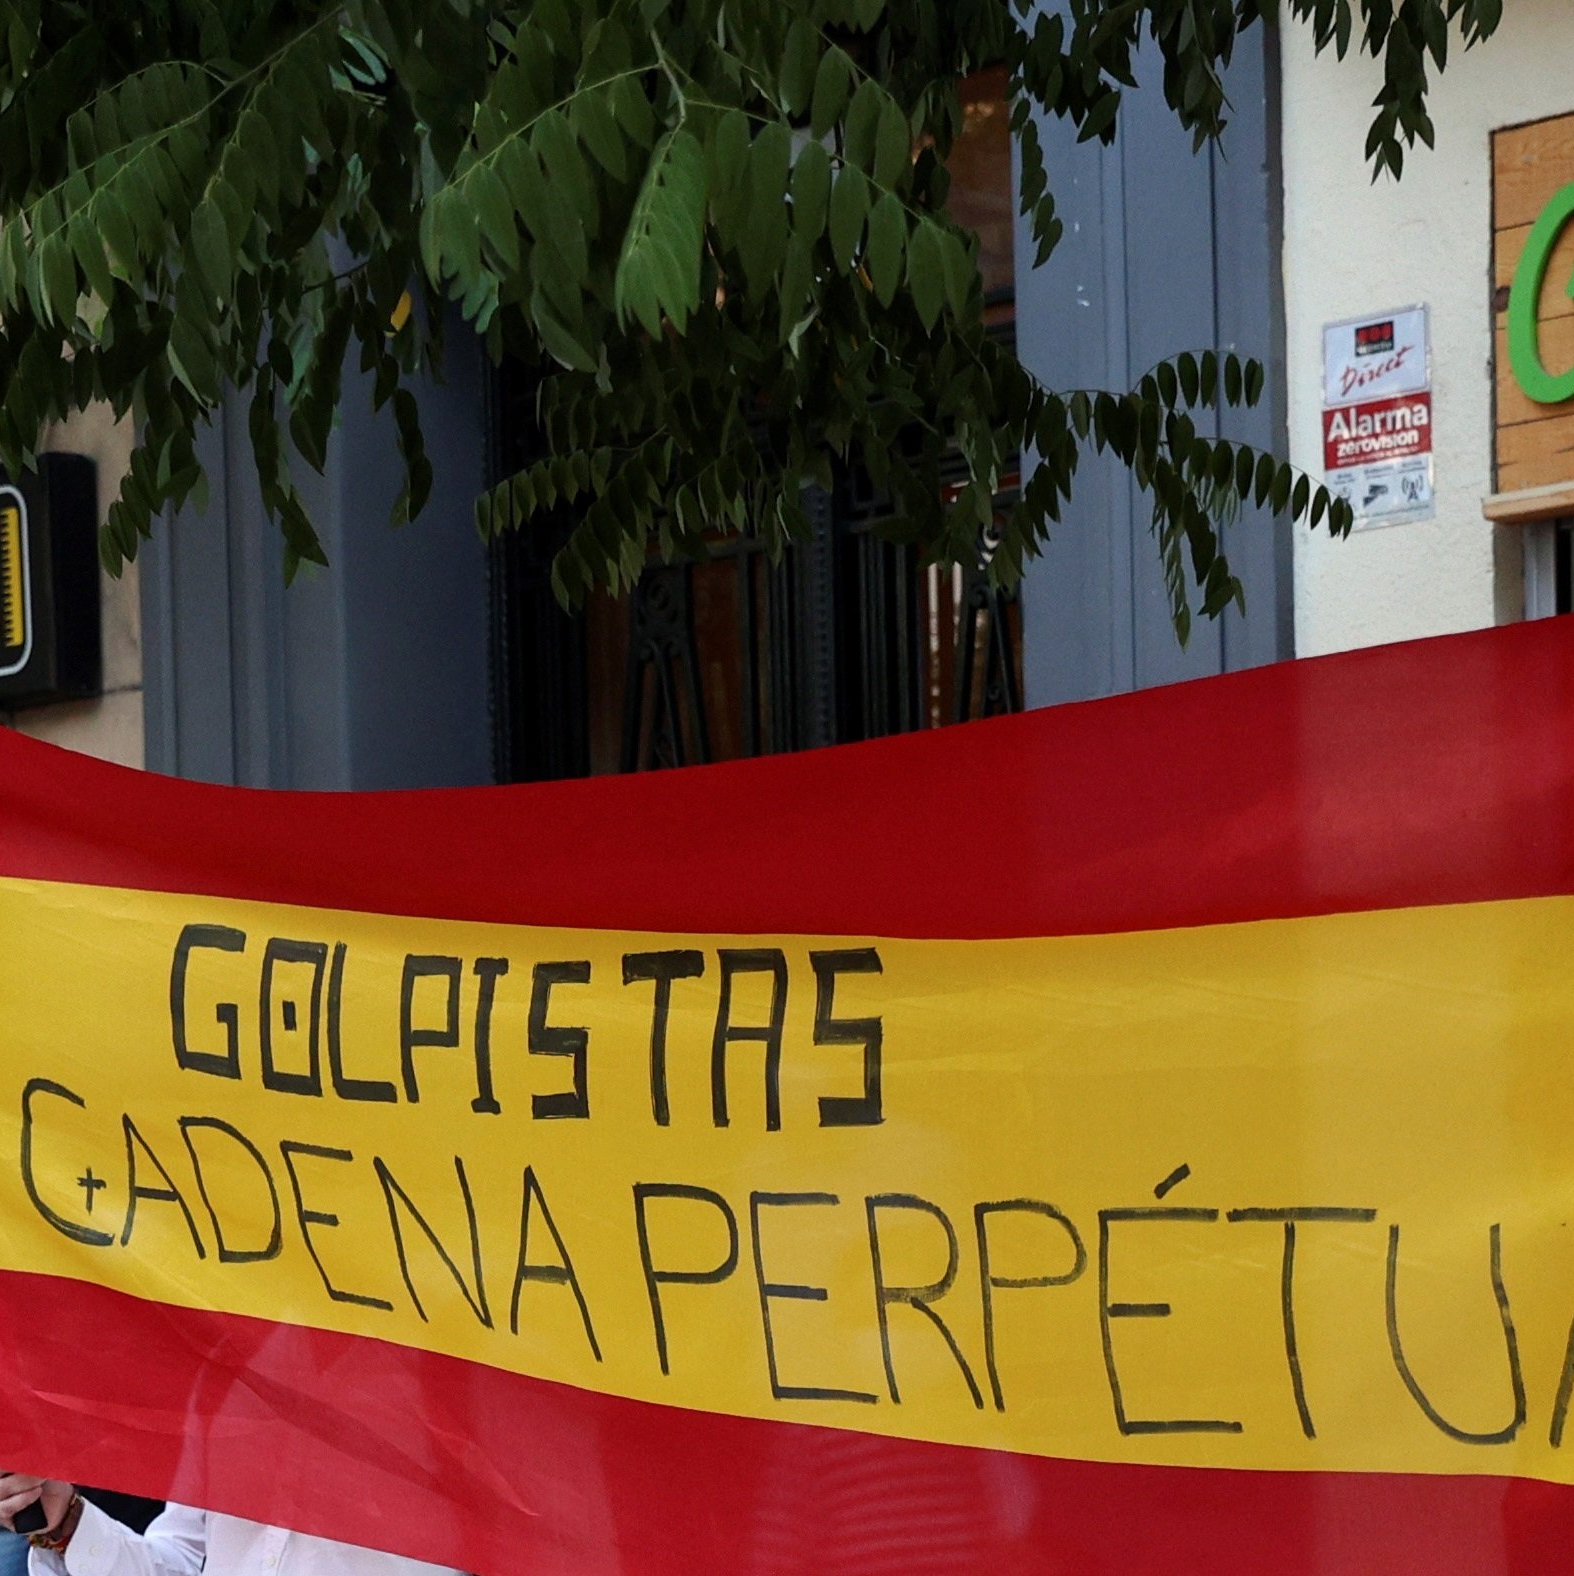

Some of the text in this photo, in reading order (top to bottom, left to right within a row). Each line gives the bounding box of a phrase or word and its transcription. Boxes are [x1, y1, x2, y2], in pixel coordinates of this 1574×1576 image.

[1340, 345, 1416, 398] Direct
[1327, 402, 1429, 442] Alarma
[1337, 428, 1420, 458] zerovision
[170, 923, 885, 1131] GOLPISTAS
[20, 1079, 602, 1363] CADENA
